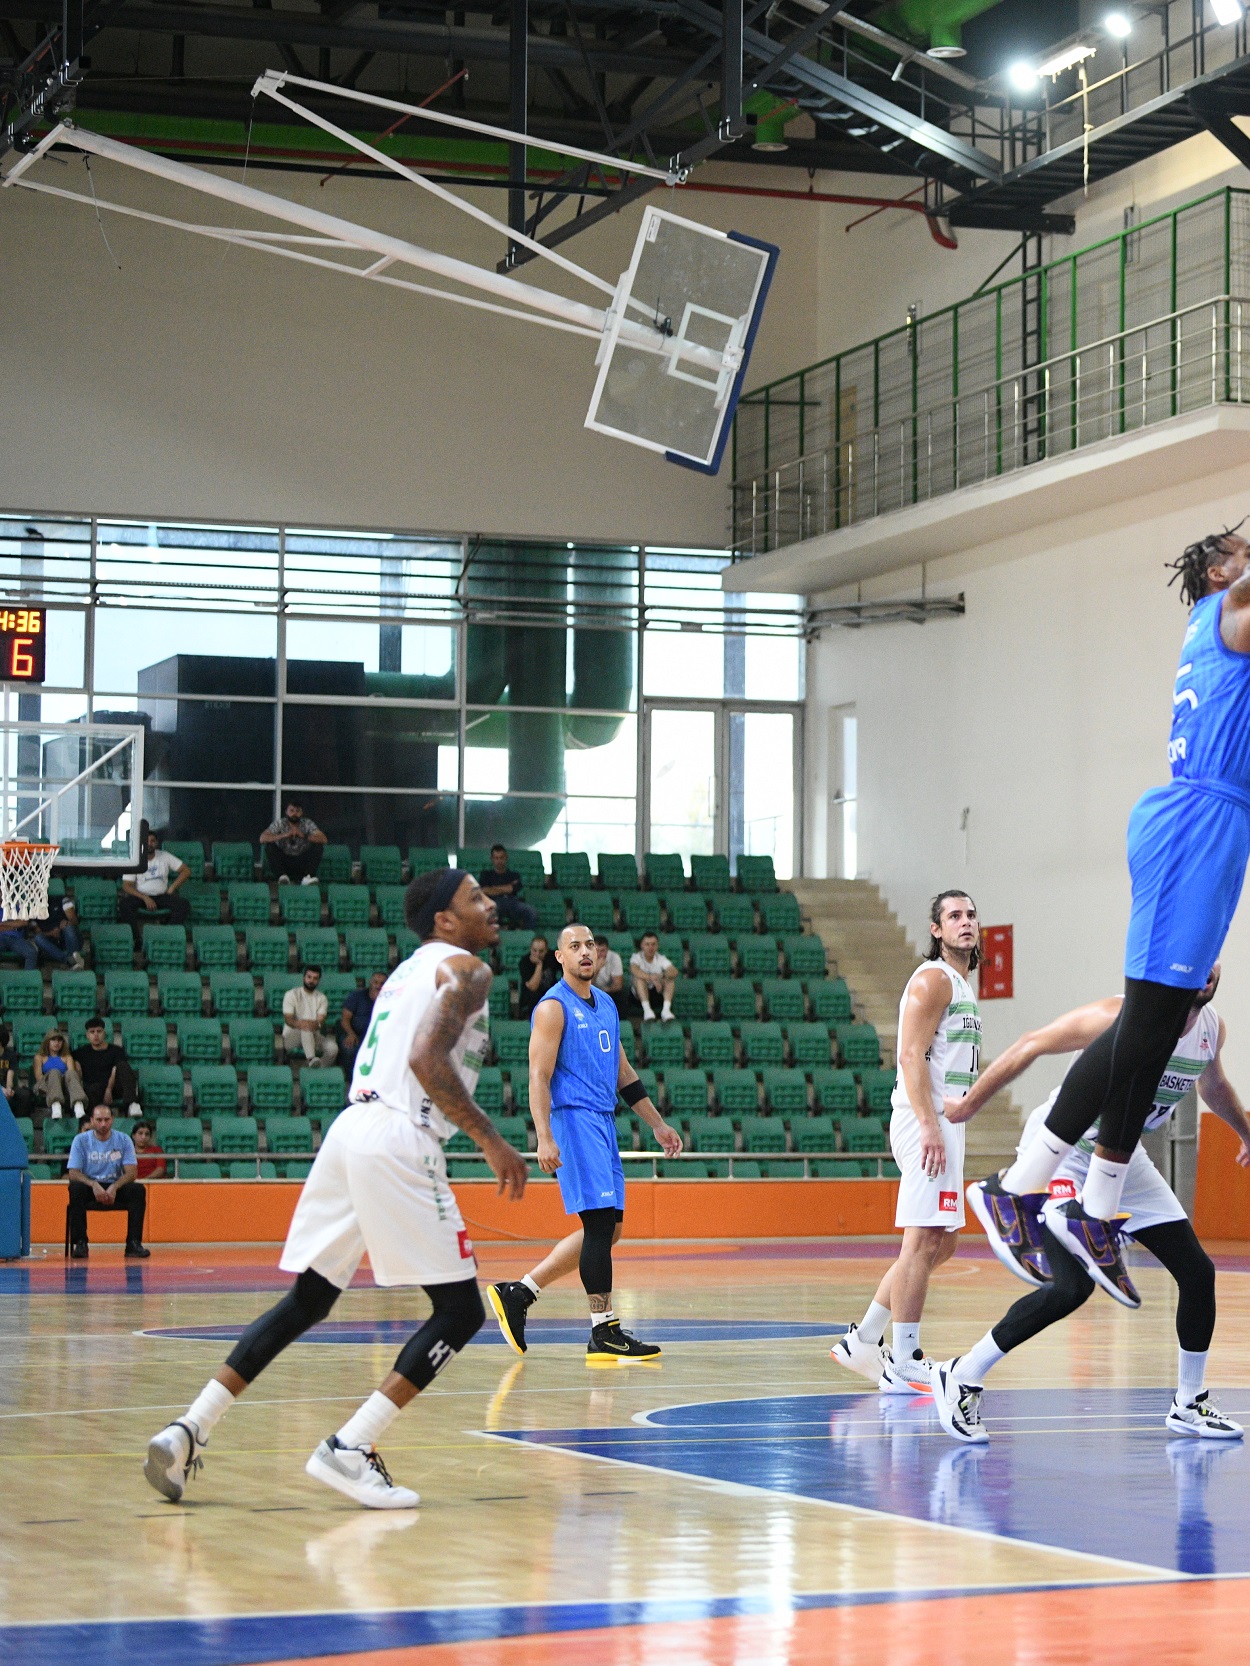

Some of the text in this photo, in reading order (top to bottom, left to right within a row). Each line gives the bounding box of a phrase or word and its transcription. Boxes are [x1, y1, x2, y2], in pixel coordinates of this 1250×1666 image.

[11, 638, 34, 678] 6
[359, 1010, 391, 1077] 5
[598, 1029, 612, 1053] 0
[1052, 1185, 1072, 1195] RM
